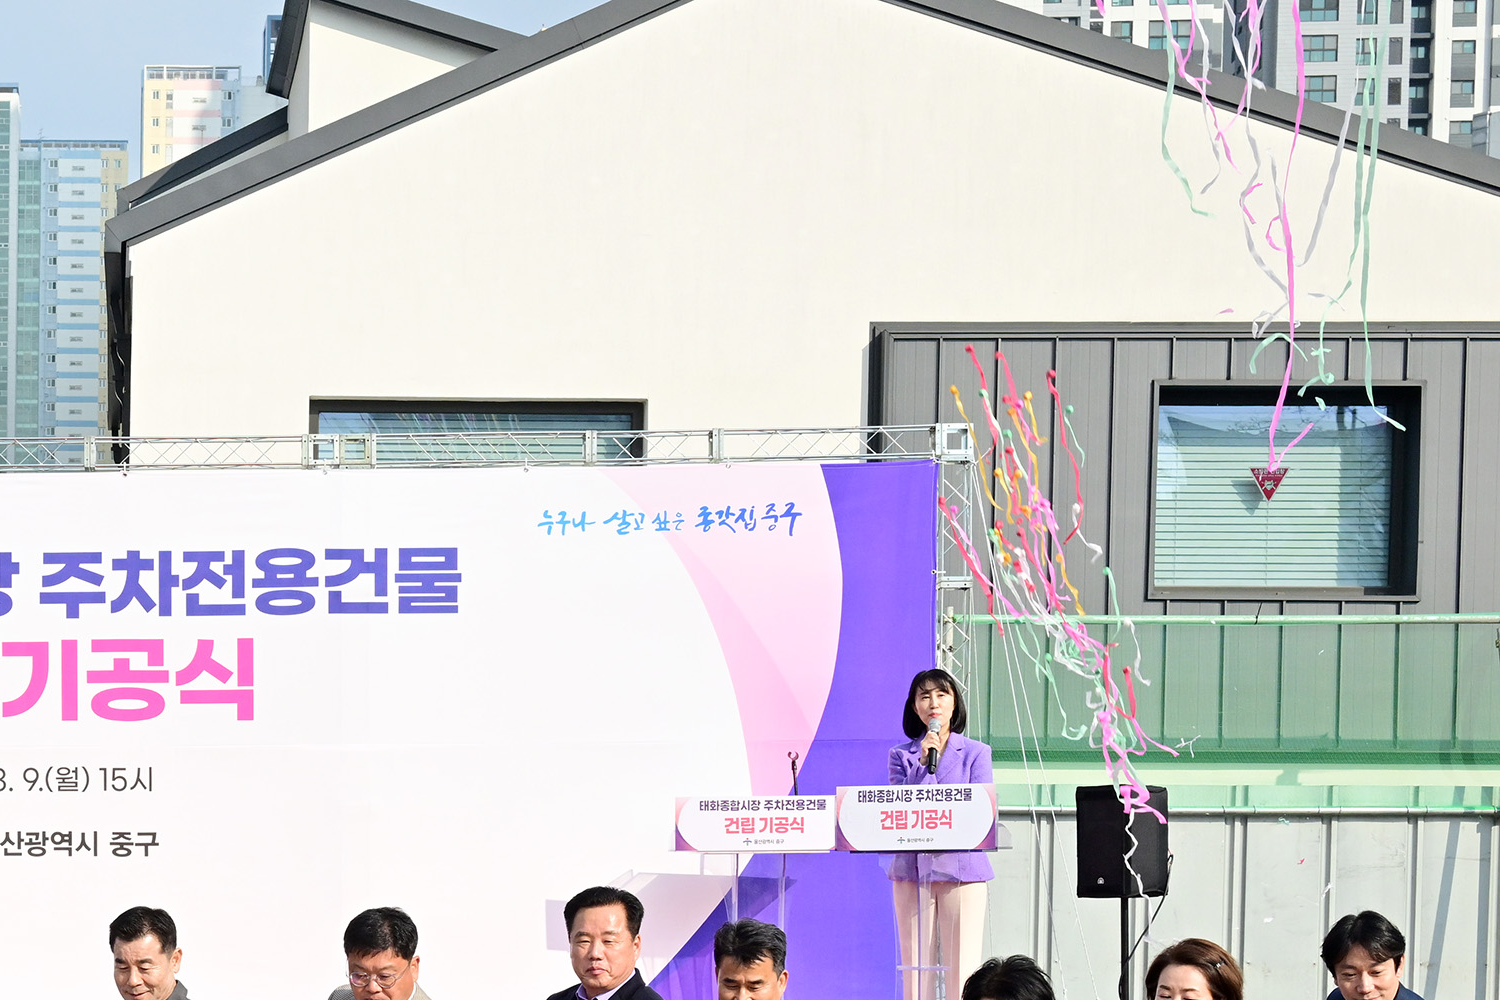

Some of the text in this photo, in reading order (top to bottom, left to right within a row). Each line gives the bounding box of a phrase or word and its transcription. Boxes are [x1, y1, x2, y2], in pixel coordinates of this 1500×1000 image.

[537, 509, 596, 536] 누구나
[603, 509, 645, 536] 살고
[652, 510, 685, 532] 싶은
[761, 502, 803, 537] 중구
[40, 547, 462, 619] 주차전용건물
[2, 638, 255, 722] 기공식
[23, 766, 90, 793] 9.(월)
[98, 766, 153, 793] 15시
[699, 798, 827, 812] 태화종합시장 주차전용건물
[858, 787, 973, 804] 태화종합시장 주차전용건물
[724, 816, 805, 834] 건립 기공식
[880, 808, 953, 830] 건립 기공식
[109, 831, 160, 858] 중구
